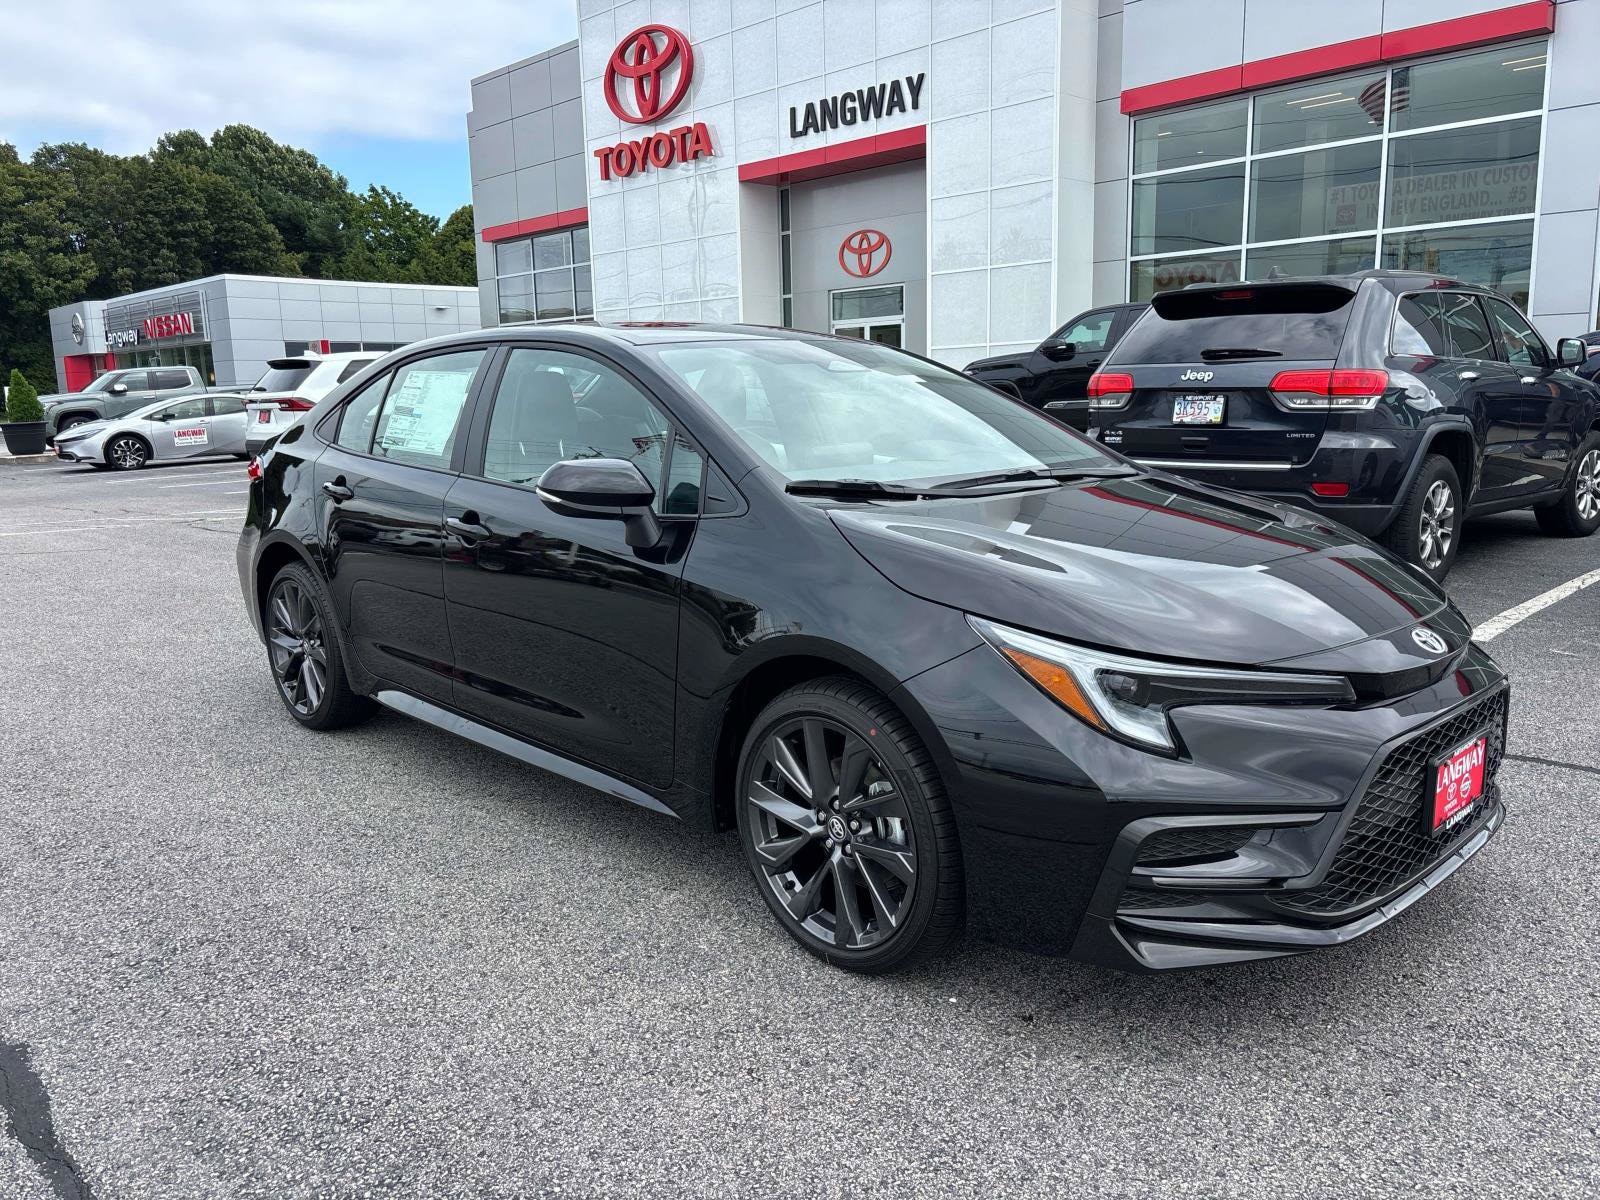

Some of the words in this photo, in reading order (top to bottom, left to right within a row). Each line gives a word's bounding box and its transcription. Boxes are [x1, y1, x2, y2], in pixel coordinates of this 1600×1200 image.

[789, 72, 925, 138] LANGWAY
[594, 122, 713, 180] TOYOTA
[1351, 180, 1403, 201] TOYA
[1407, 173, 1457, 195] DEALER
[1462, 170, 1479, 187] IN
[1508, 186, 1528, 203] #5
[105, 328, 139, 347] Langway
[143, 311, 194, 340] NISSAN
[1181, 369, 1214, 382] Jeep
[1175, 401, 1211, 416] 3K595
[173, 428, 206, 438] LANGWAY
[1436, 743, 1485, 794] LANGWAY
[1446, 802, 1474, 829] LANGWAY
